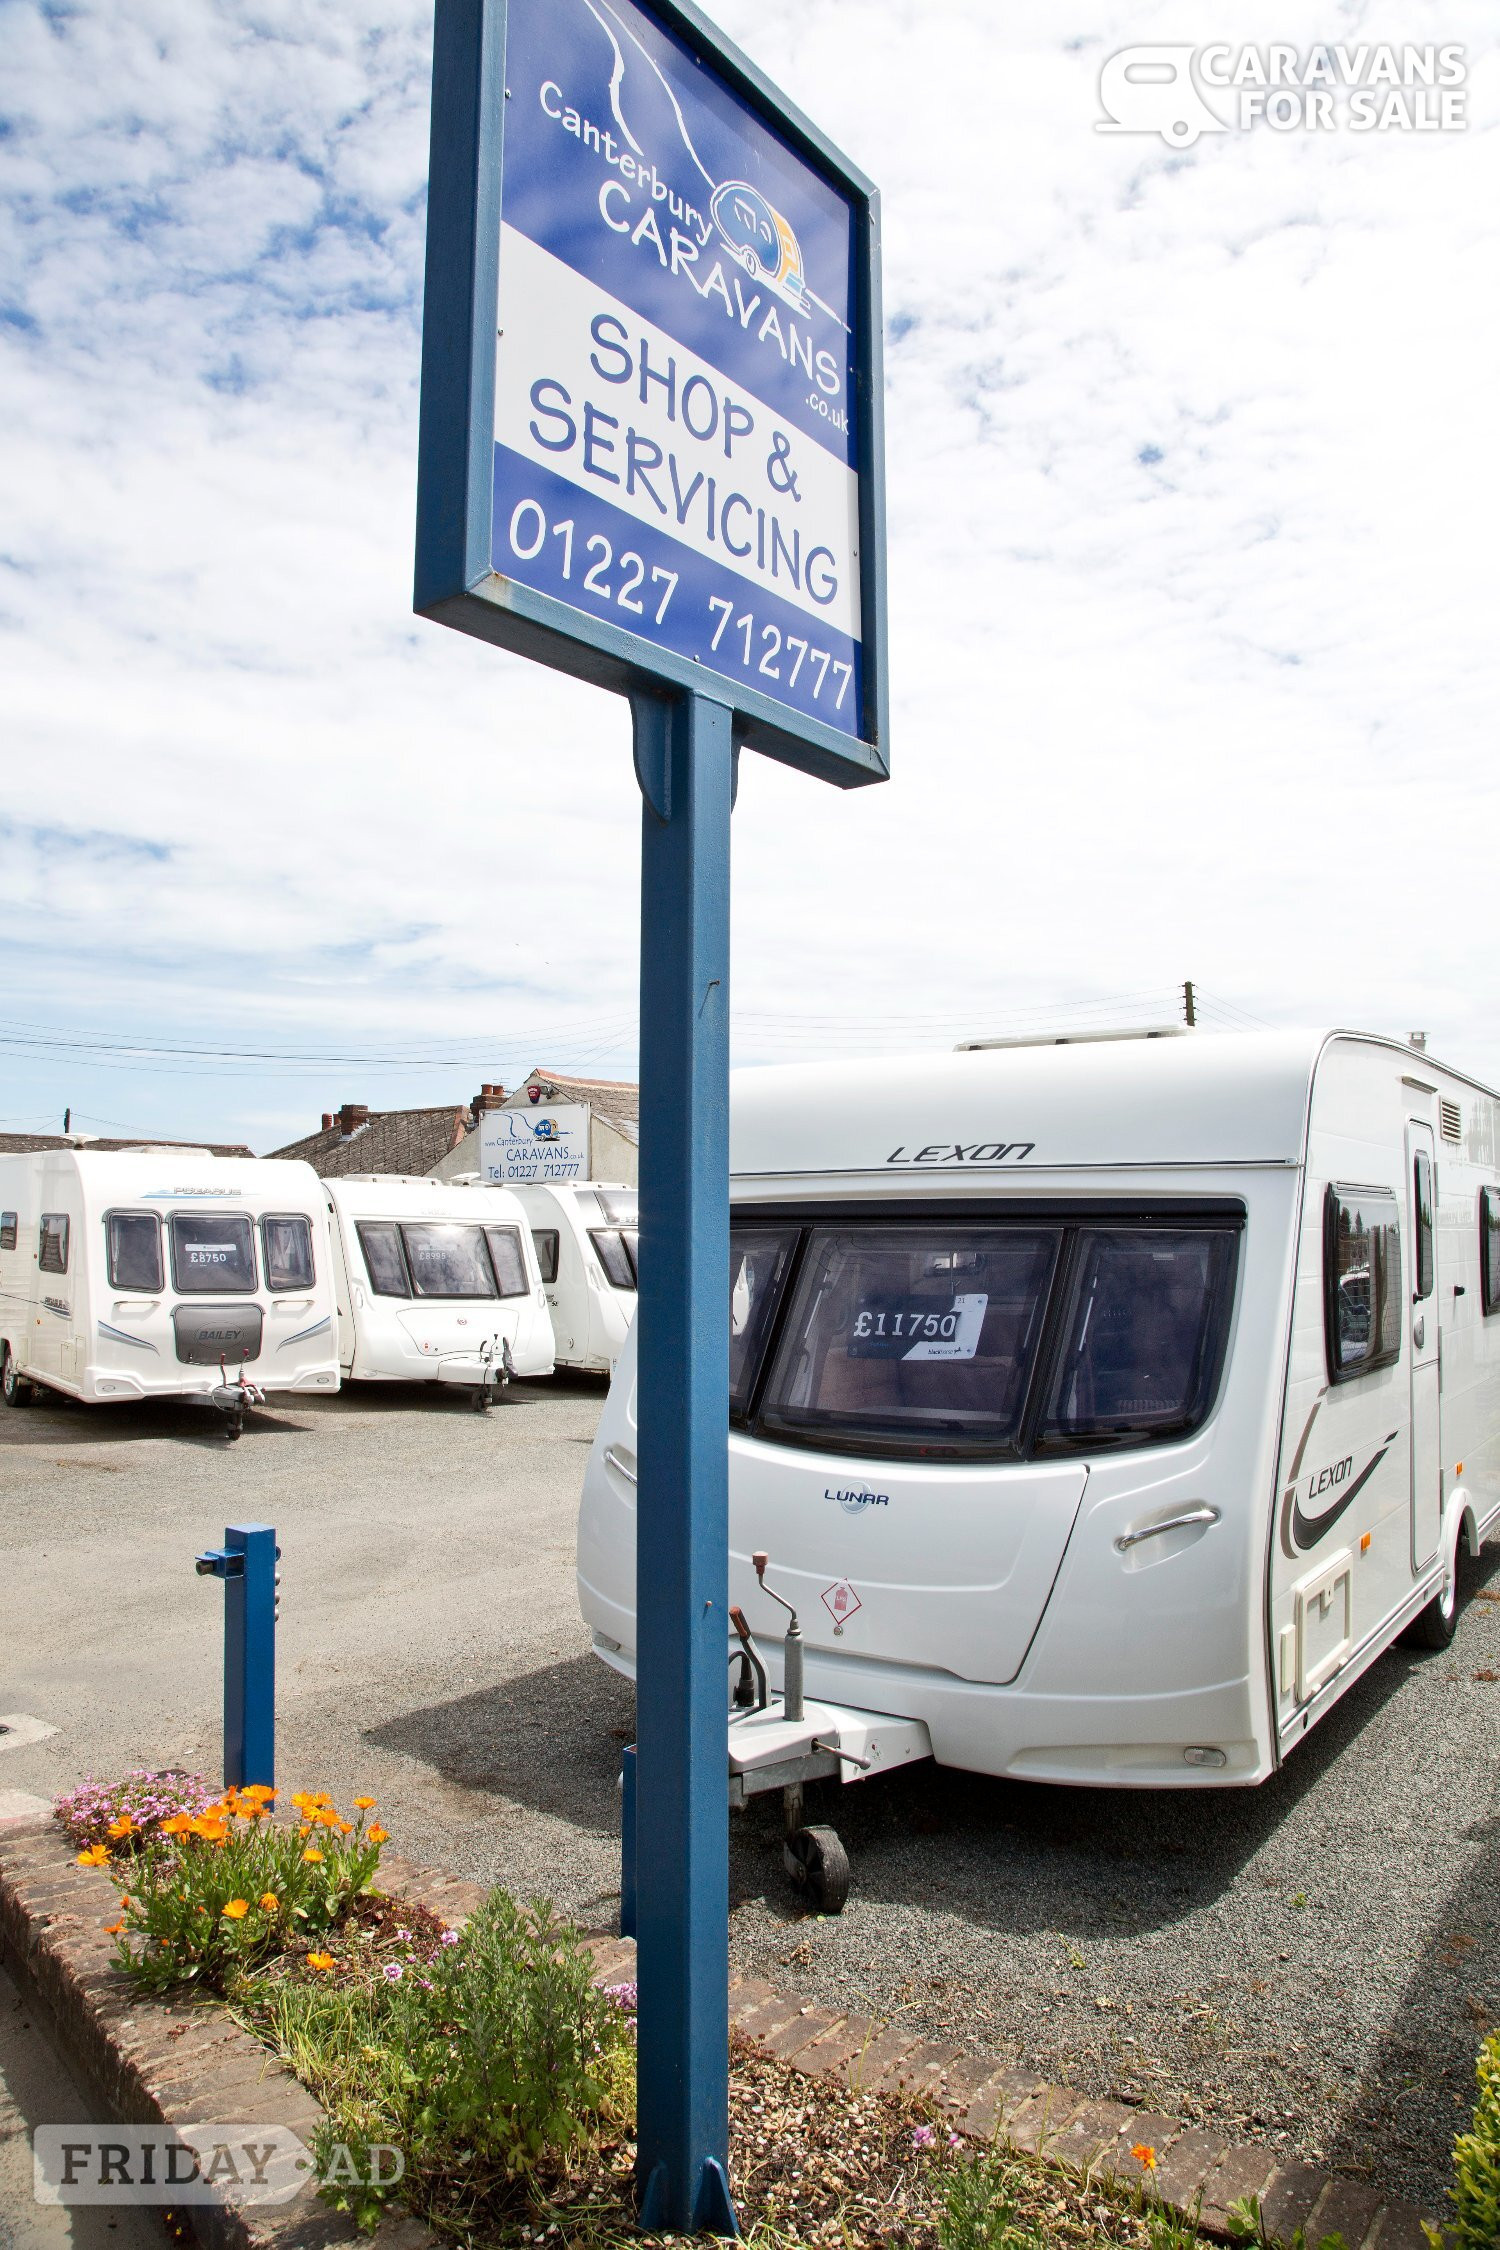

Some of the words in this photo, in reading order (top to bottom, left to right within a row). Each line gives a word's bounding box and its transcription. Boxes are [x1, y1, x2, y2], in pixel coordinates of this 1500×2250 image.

[539, 80, 713, 247] Canterbury
[598, 179, 841, 396] CARAVANS
[590, 313, 754, 459] SHOP
[766, 430, 802, 503] &
[805, 393, 849, 436] .co.uk
[529, 378, 838, 606] SERVICING
[509, 498, 679, 625] 01227
[708, 595, 853, 710] 712777
[496, 1136, 533, 1147] Canterbury
[506, 1146, 569, 1161] CARAVANS
[886, 1142, 1036, 1164] LEXON
[488, 1164, 505, 1179] Tel:
[507, 1165, 538, 1178] 01227
[543, 1163, 580, 1178] 712777
[190, 1252, 227, 1263] £8750
[198, 1330, 241, 1340] BAILEY
[853, 1311, 957, 1338] £11750
[1308, 1455, 1353, 1500] LEXON
[824, 1488, 890, 1506] LUNAR
